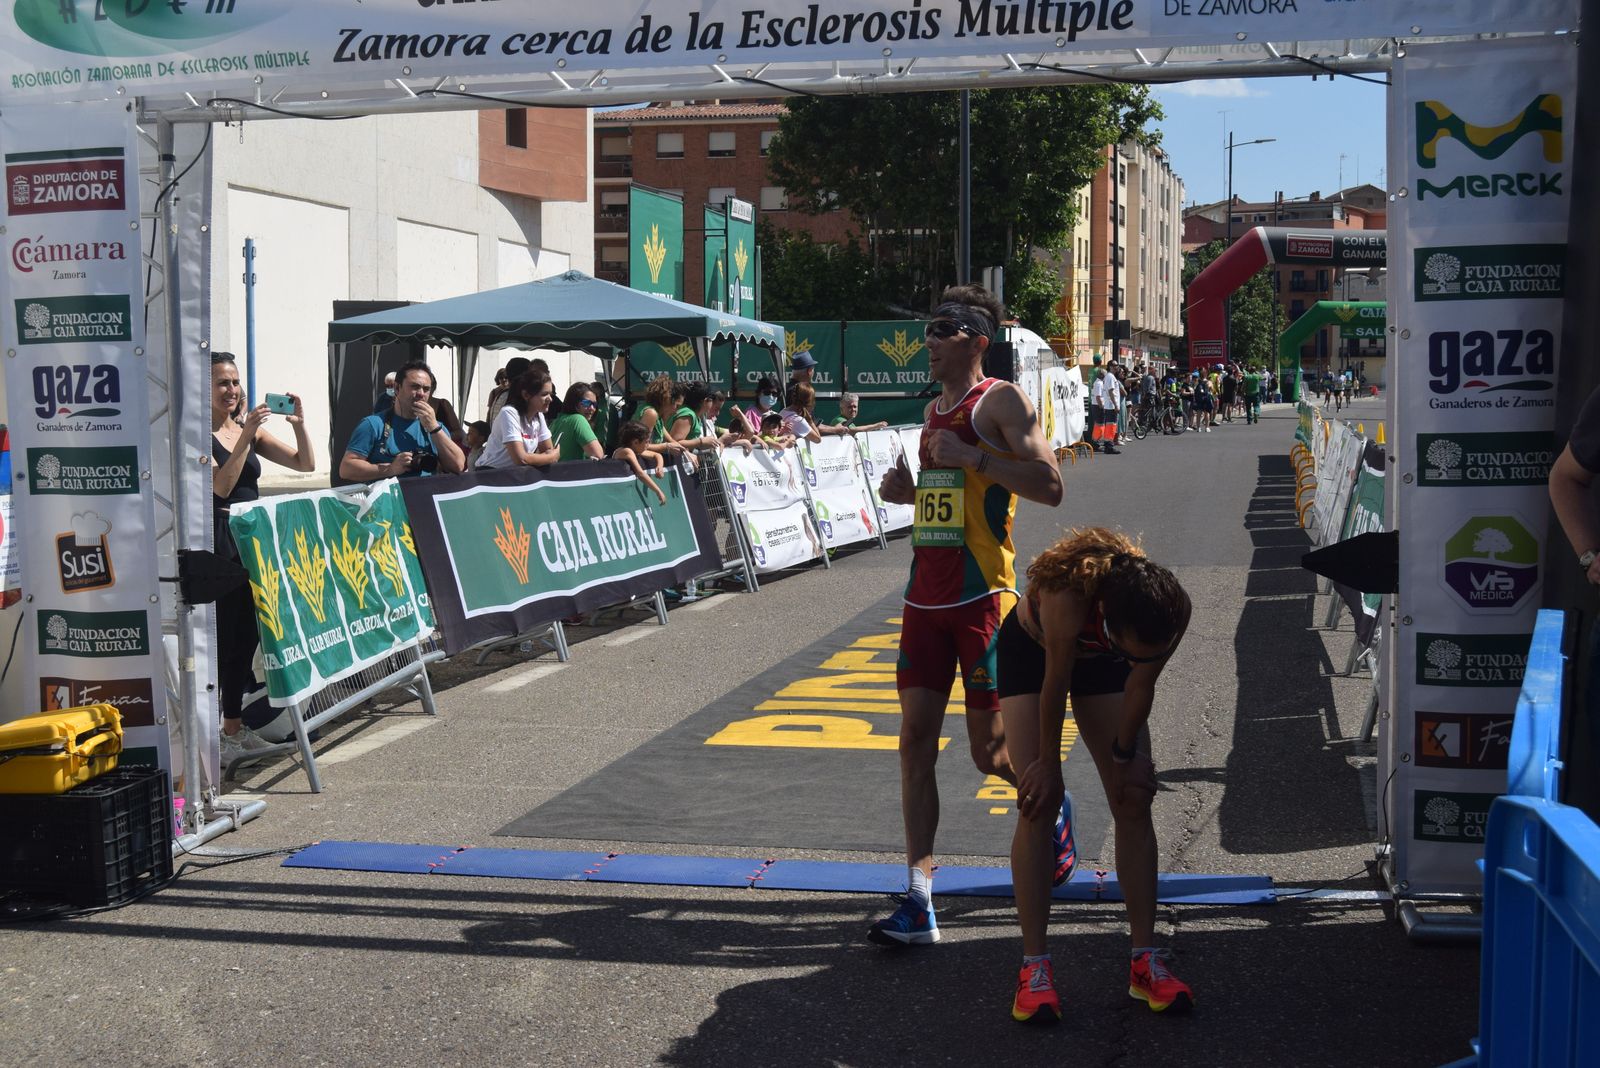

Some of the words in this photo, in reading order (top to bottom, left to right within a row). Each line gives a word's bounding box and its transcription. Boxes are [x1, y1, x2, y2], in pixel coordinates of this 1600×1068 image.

[1164, 0, 1191, 16] DE
[1198, 0, 1298, 16] ZAMORA
[333, 28, 491, 63] Zamora
[501, 28, 612, 56] cerca
[624, 15, 672, 53] de
[685, 11, 724, 51] la
[736, 2, 941, 49] Esclerosis
[12, 67, 81, 88] ASOCIACIÓN
[87, 63, 152, 82] ZAMORANA
[158, 61, 175, 77] DE
[180, 56, 249, 74] ESCLEROSIS
[254, 50, 310, 69] MÚLTIPLE
[33, 169, 98, 184] DIPUTACIÓN
[101, 170, 118, 180] DE
[33, 182, 119, 204] ZAMORA
[1342, 236, 1366, 246] CON
[1369, 237, 1381, 246] EL
[1297, 246, 1330, 254] ZAMORA
[1342, 249, 1386, 259] GANAMO
[52, 269, 87, 280] Zamora
[1464, 264, 1561, 279] FUNDACION
[1465, 280, 1505, 294] CAJA
[1509, 279, 1561, 292] RURAL
[52, 312, 124, 325] FUNDACION
[53, 326, 76, 338] CAJA
[78, 324, 124, 337] RURAL
[1429, 329, 1554, 394] gaza
[857, 371, 892, 384] CAJA
[896, 371, 941, 384] RURA
[32, 364, 121, 419] gaza
[1429, 397, 1492, 409] Ganaderos
[1495, 397, 1510, 408] de
[1512, 396, 1554, 409] Zamora
[36, 422, 74, 432] Ganaderos
[74, 421, 84, 432] de
[85, 421, 122, 432] Zamora
[1466, 451, 1552, 465] FUNDACIO
[62, 465, 131, 477] FUNDACION
[1466, 467, 1505, 481] CAJA
[1511, 467, 1550, 479] RURA
[62, 478, 83, 490] CAJA
[86, 477, 132, 490] RURAL
[920, 493, 953, 523] 165
[536, 517, 592, 573] CAJA
[591, 506, 667, 562] RURAL
[62, 547, 106, 579] Susi
[68, 627, 141, 640] FUNDACION
[69, 640, 92, 653] CAJA
[95, 640, 142, 653] RURAL
[309, 637, 325, 655] CAJA
[323, 627, 346, 648] RURAL
[1465, 654, 1528, 667] FUNDAC
[1465, 668, 1505, 682] CAJA
[1463, 825, 1485, 837] CA
